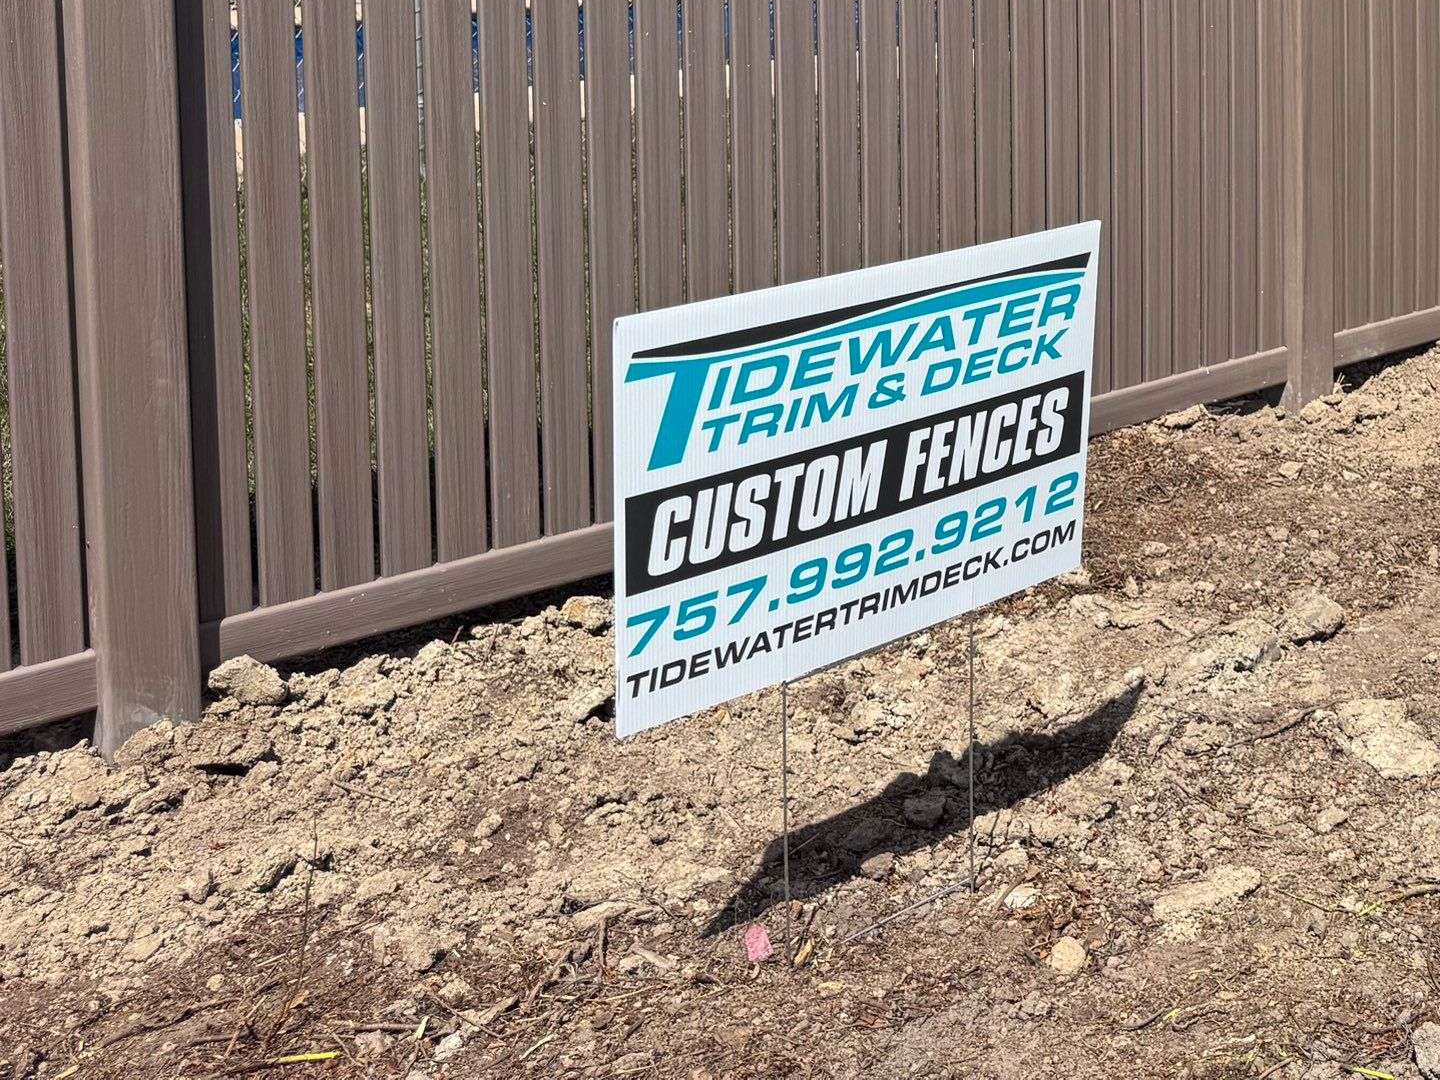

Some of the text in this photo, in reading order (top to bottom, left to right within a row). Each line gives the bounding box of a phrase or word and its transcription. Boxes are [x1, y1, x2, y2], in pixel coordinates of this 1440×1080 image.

[624, 283, 1081, 472] TIDEWATER
[701, 328, 1068, 453] TRIM & DECK
[626, 471, 1079, 658] 757.992.9212
[647, 387, 1070, 577] CUSTOM FENCES
[626, 519, 1076, 699] TIDEWATERTRIMDECK.COM
